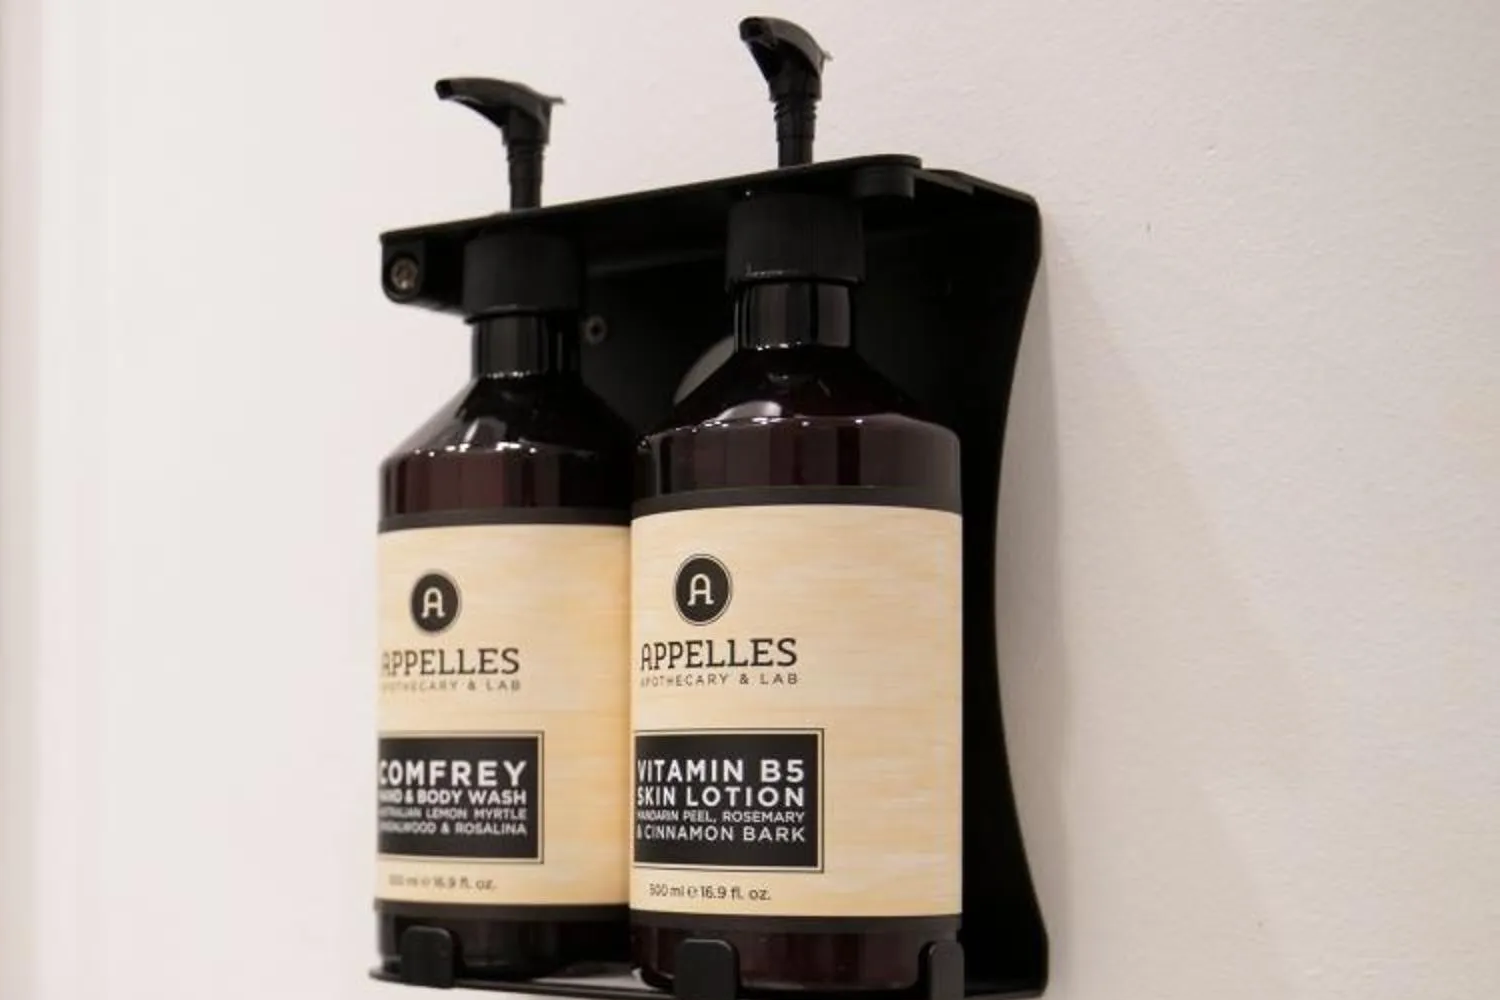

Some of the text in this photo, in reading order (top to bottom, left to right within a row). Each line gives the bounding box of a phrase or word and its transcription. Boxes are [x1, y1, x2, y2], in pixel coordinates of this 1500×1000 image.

[382, 648, 520, 676] APPELLES
[641, 638, 797, 671] APPELLES
[641, 673, 798, 687] APOTHECARY & LAB
[379, 760, 527, 786] COMFREY
[637, 759, 805, 782] VITAMIN B5
[417, 789, 462, 805] BODY
[468, 790, 527, 805] WASH
[637, 786, 804, 807] SKIN LOTION
[426, 808, 467, 820] LEMON
[474, 808, 528, 820] MYRTLE
[722, 811, 805, 823] ROSEMARY
[455, 822, 528, 836] ROSALINA
[644, 825, 733, 841] CINNAMON
[743, 826, 805, 842] BARK
[700, 886, 727, 899] 16.9
